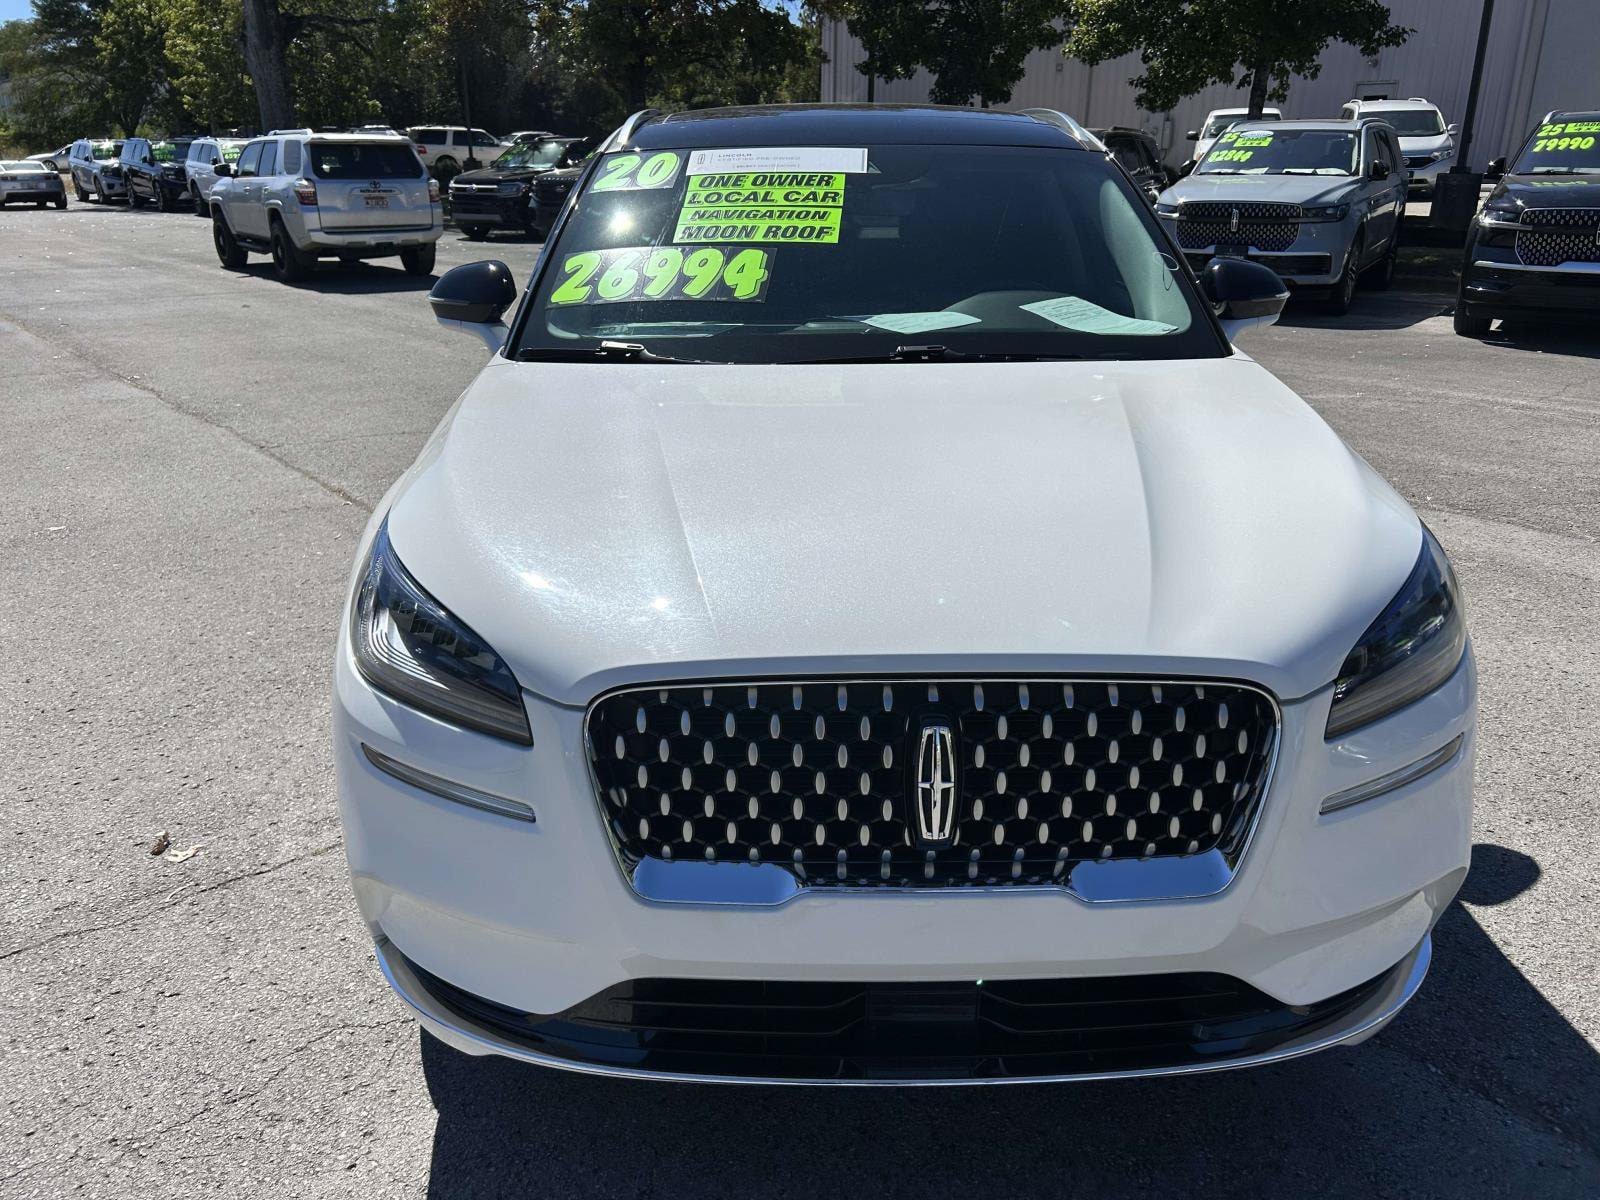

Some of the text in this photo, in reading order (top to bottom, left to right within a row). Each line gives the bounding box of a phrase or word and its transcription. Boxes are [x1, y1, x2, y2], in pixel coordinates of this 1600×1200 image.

[1536, 124, 1566, 136] 25
[594, 152, 680, 190] 20
[698, 174, 834, 188] ONE OWNER
[687, 190, 841, 205] LOCAL CAR
[690, 209, 830, 221] NAVIGATION
[679, 225, 834, 240] MOON ROOF
[551, 249, 769, 303] 26994
